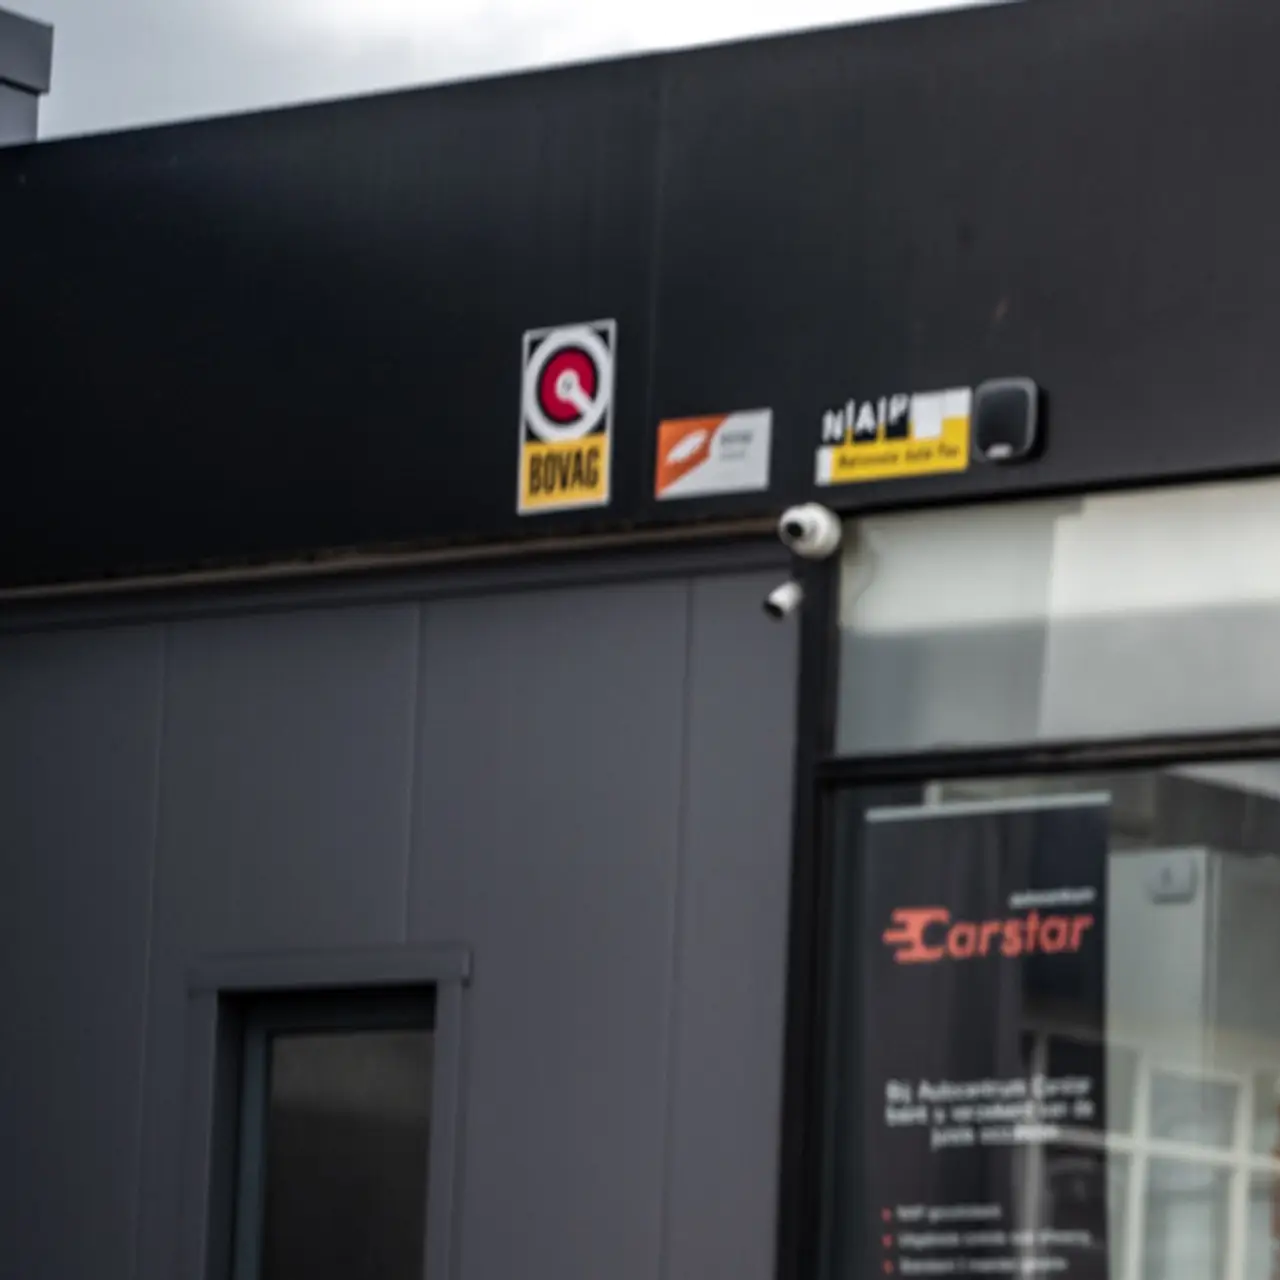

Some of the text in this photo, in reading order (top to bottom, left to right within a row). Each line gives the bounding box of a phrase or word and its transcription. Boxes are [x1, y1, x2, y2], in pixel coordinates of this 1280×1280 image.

[822, 394, 909, 444] NAP
[529, 446, 600, 496] BOVAG
[882, 905, 1094, 964] Carstar
